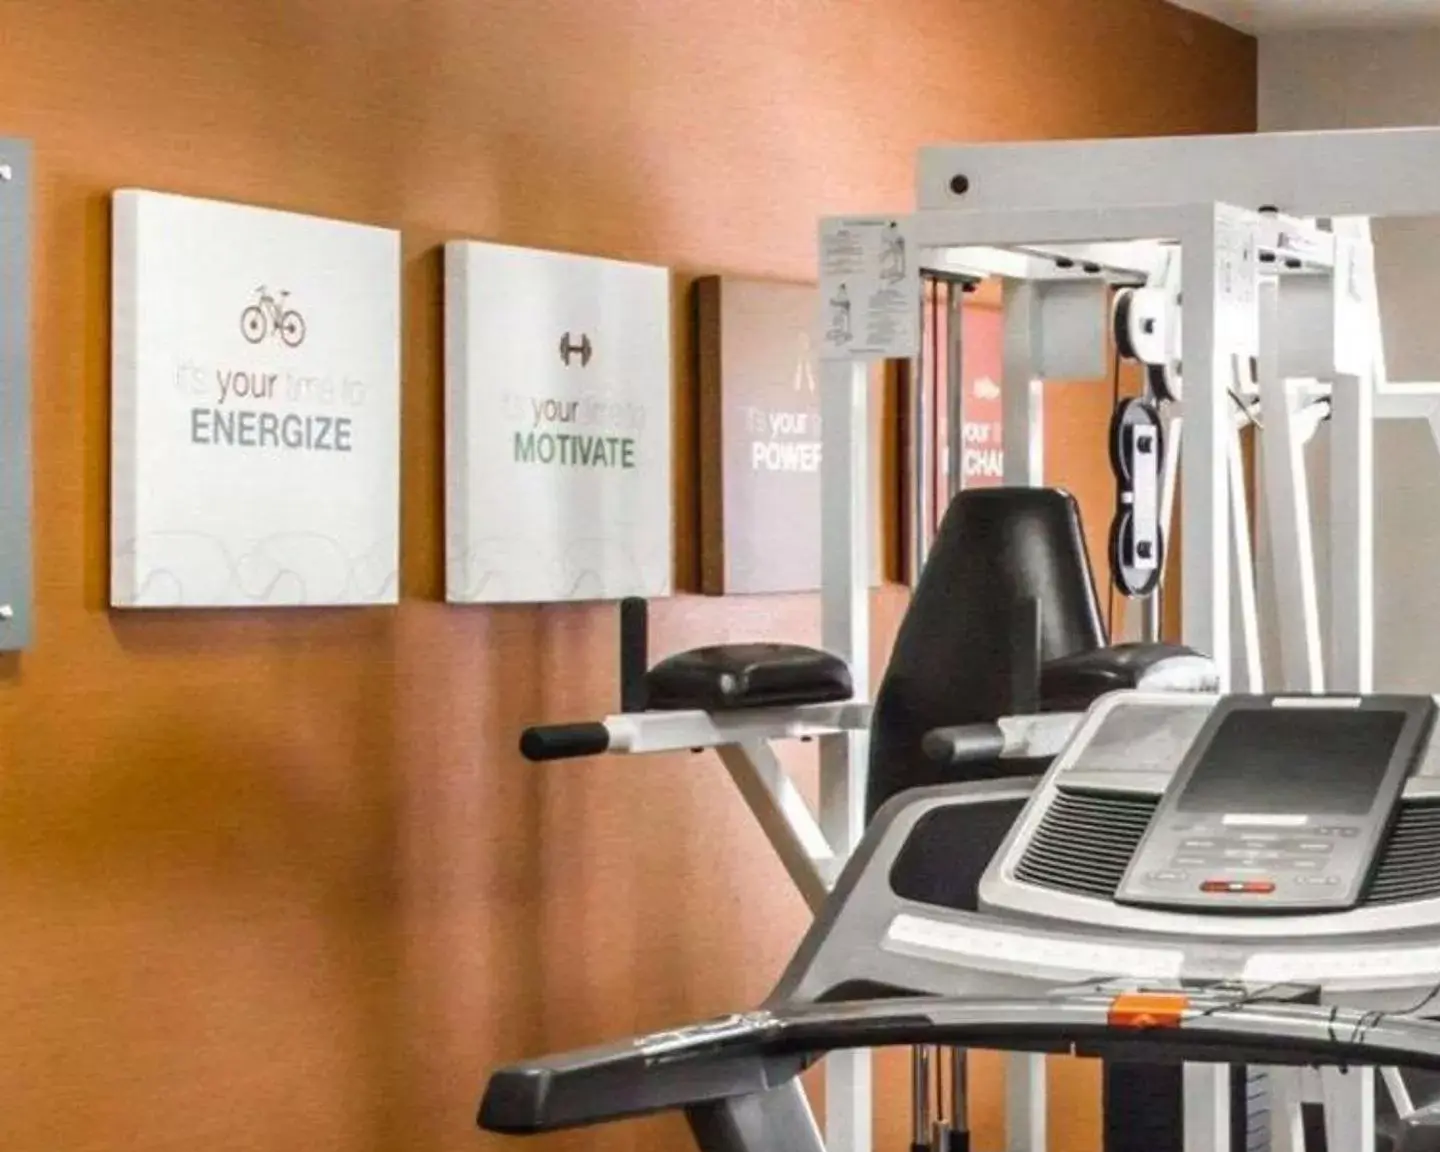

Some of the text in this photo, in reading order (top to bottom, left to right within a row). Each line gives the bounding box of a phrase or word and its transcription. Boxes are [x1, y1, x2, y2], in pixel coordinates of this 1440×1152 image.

[217, 369, 278, 404] your
[190, 407, 352, 452] ENERGIZE
[532, 397, 579, 428] your
[768, 412, 808, 439] your
[513, 431, 636, 469] MOTIVATE
